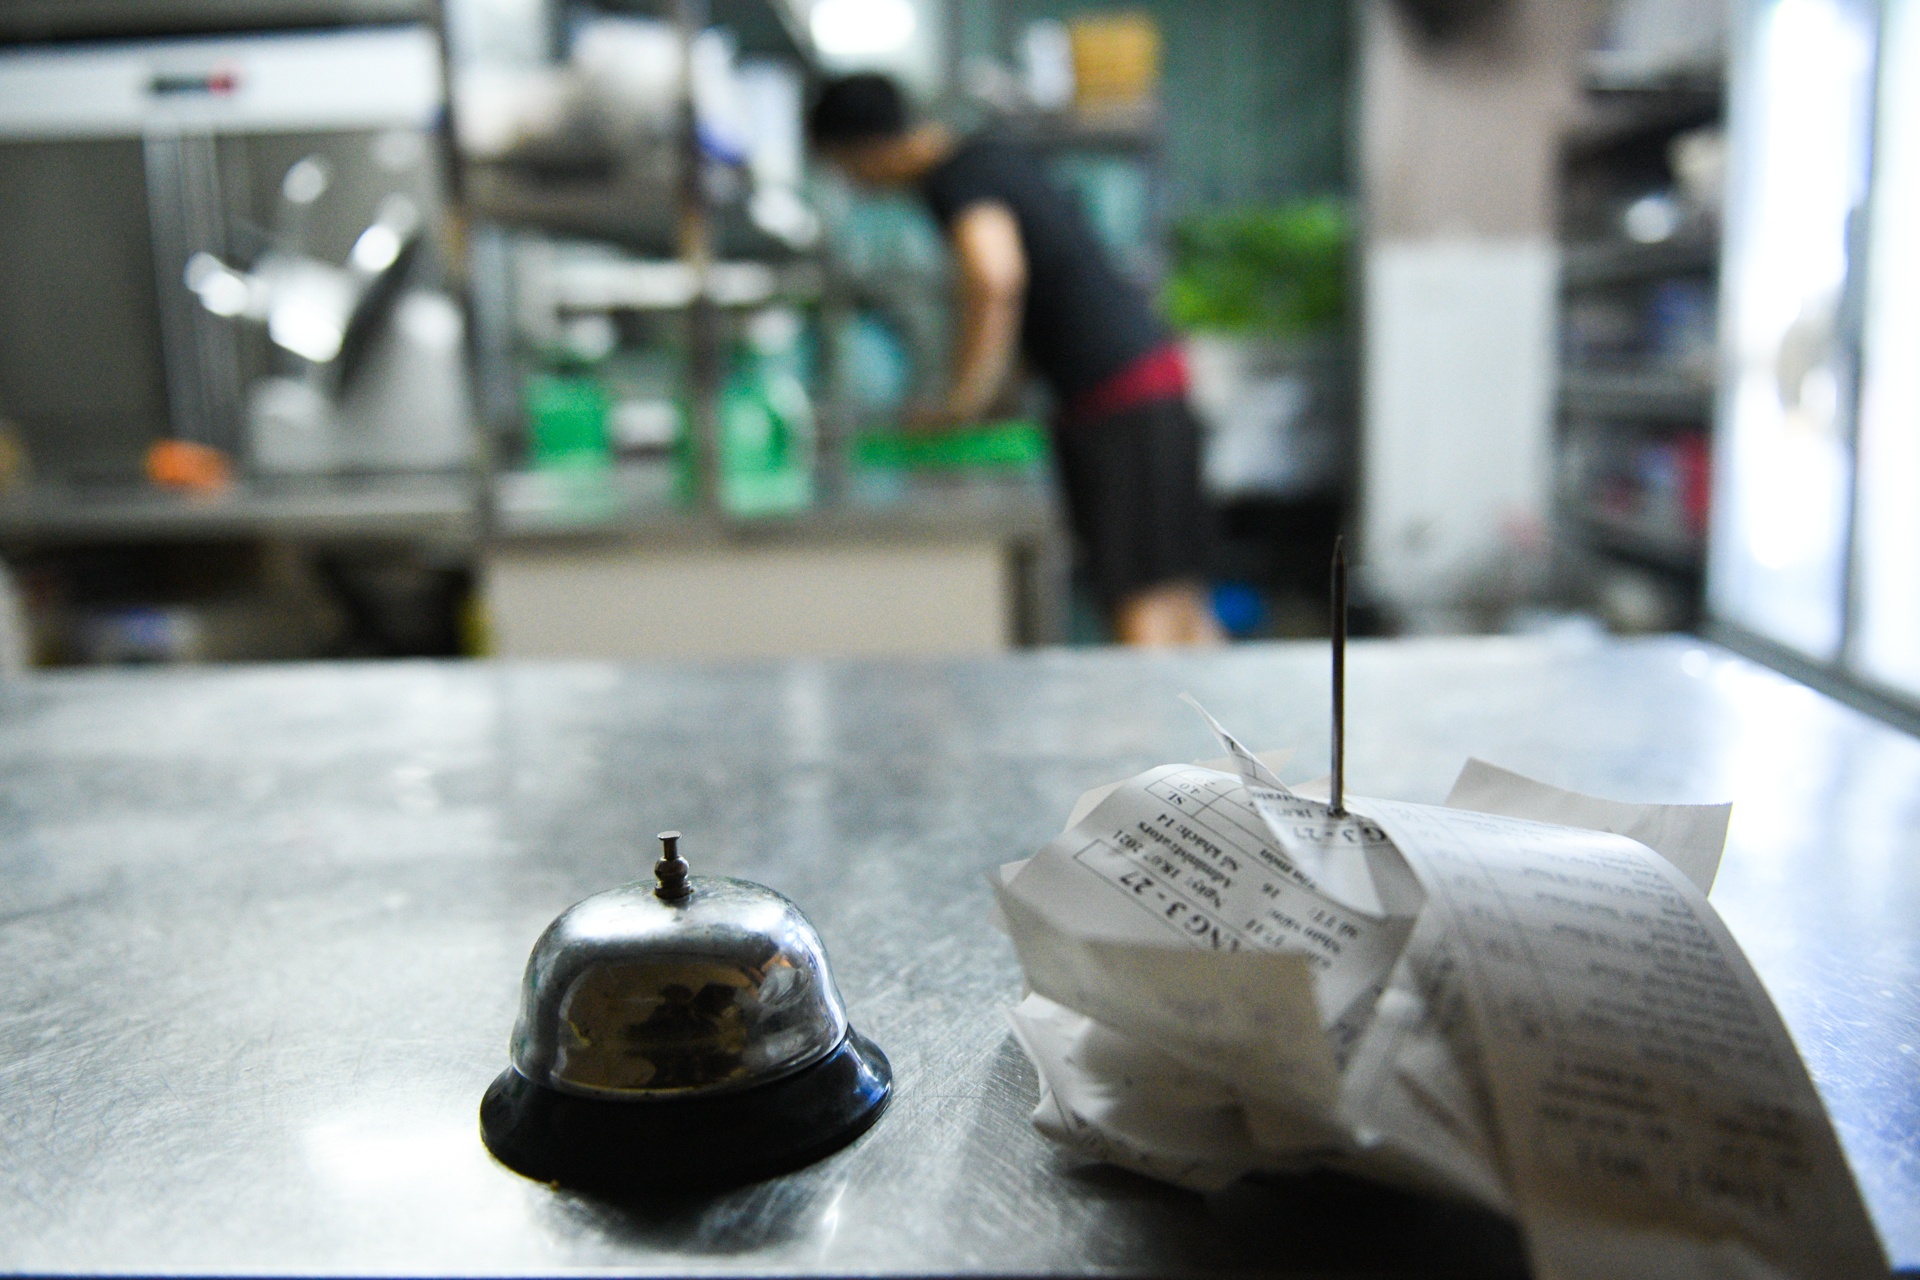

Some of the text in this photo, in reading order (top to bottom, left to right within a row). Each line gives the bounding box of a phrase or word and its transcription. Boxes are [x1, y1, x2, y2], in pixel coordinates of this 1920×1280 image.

[1167, 790, 1186, 805] SL
[1156, 813, 1175, 828] 14
[1138, 821, 1234, 888] Administrators
[1120, 871, 1154, 894] 27
[1166, 901, 1187, 918] 3
